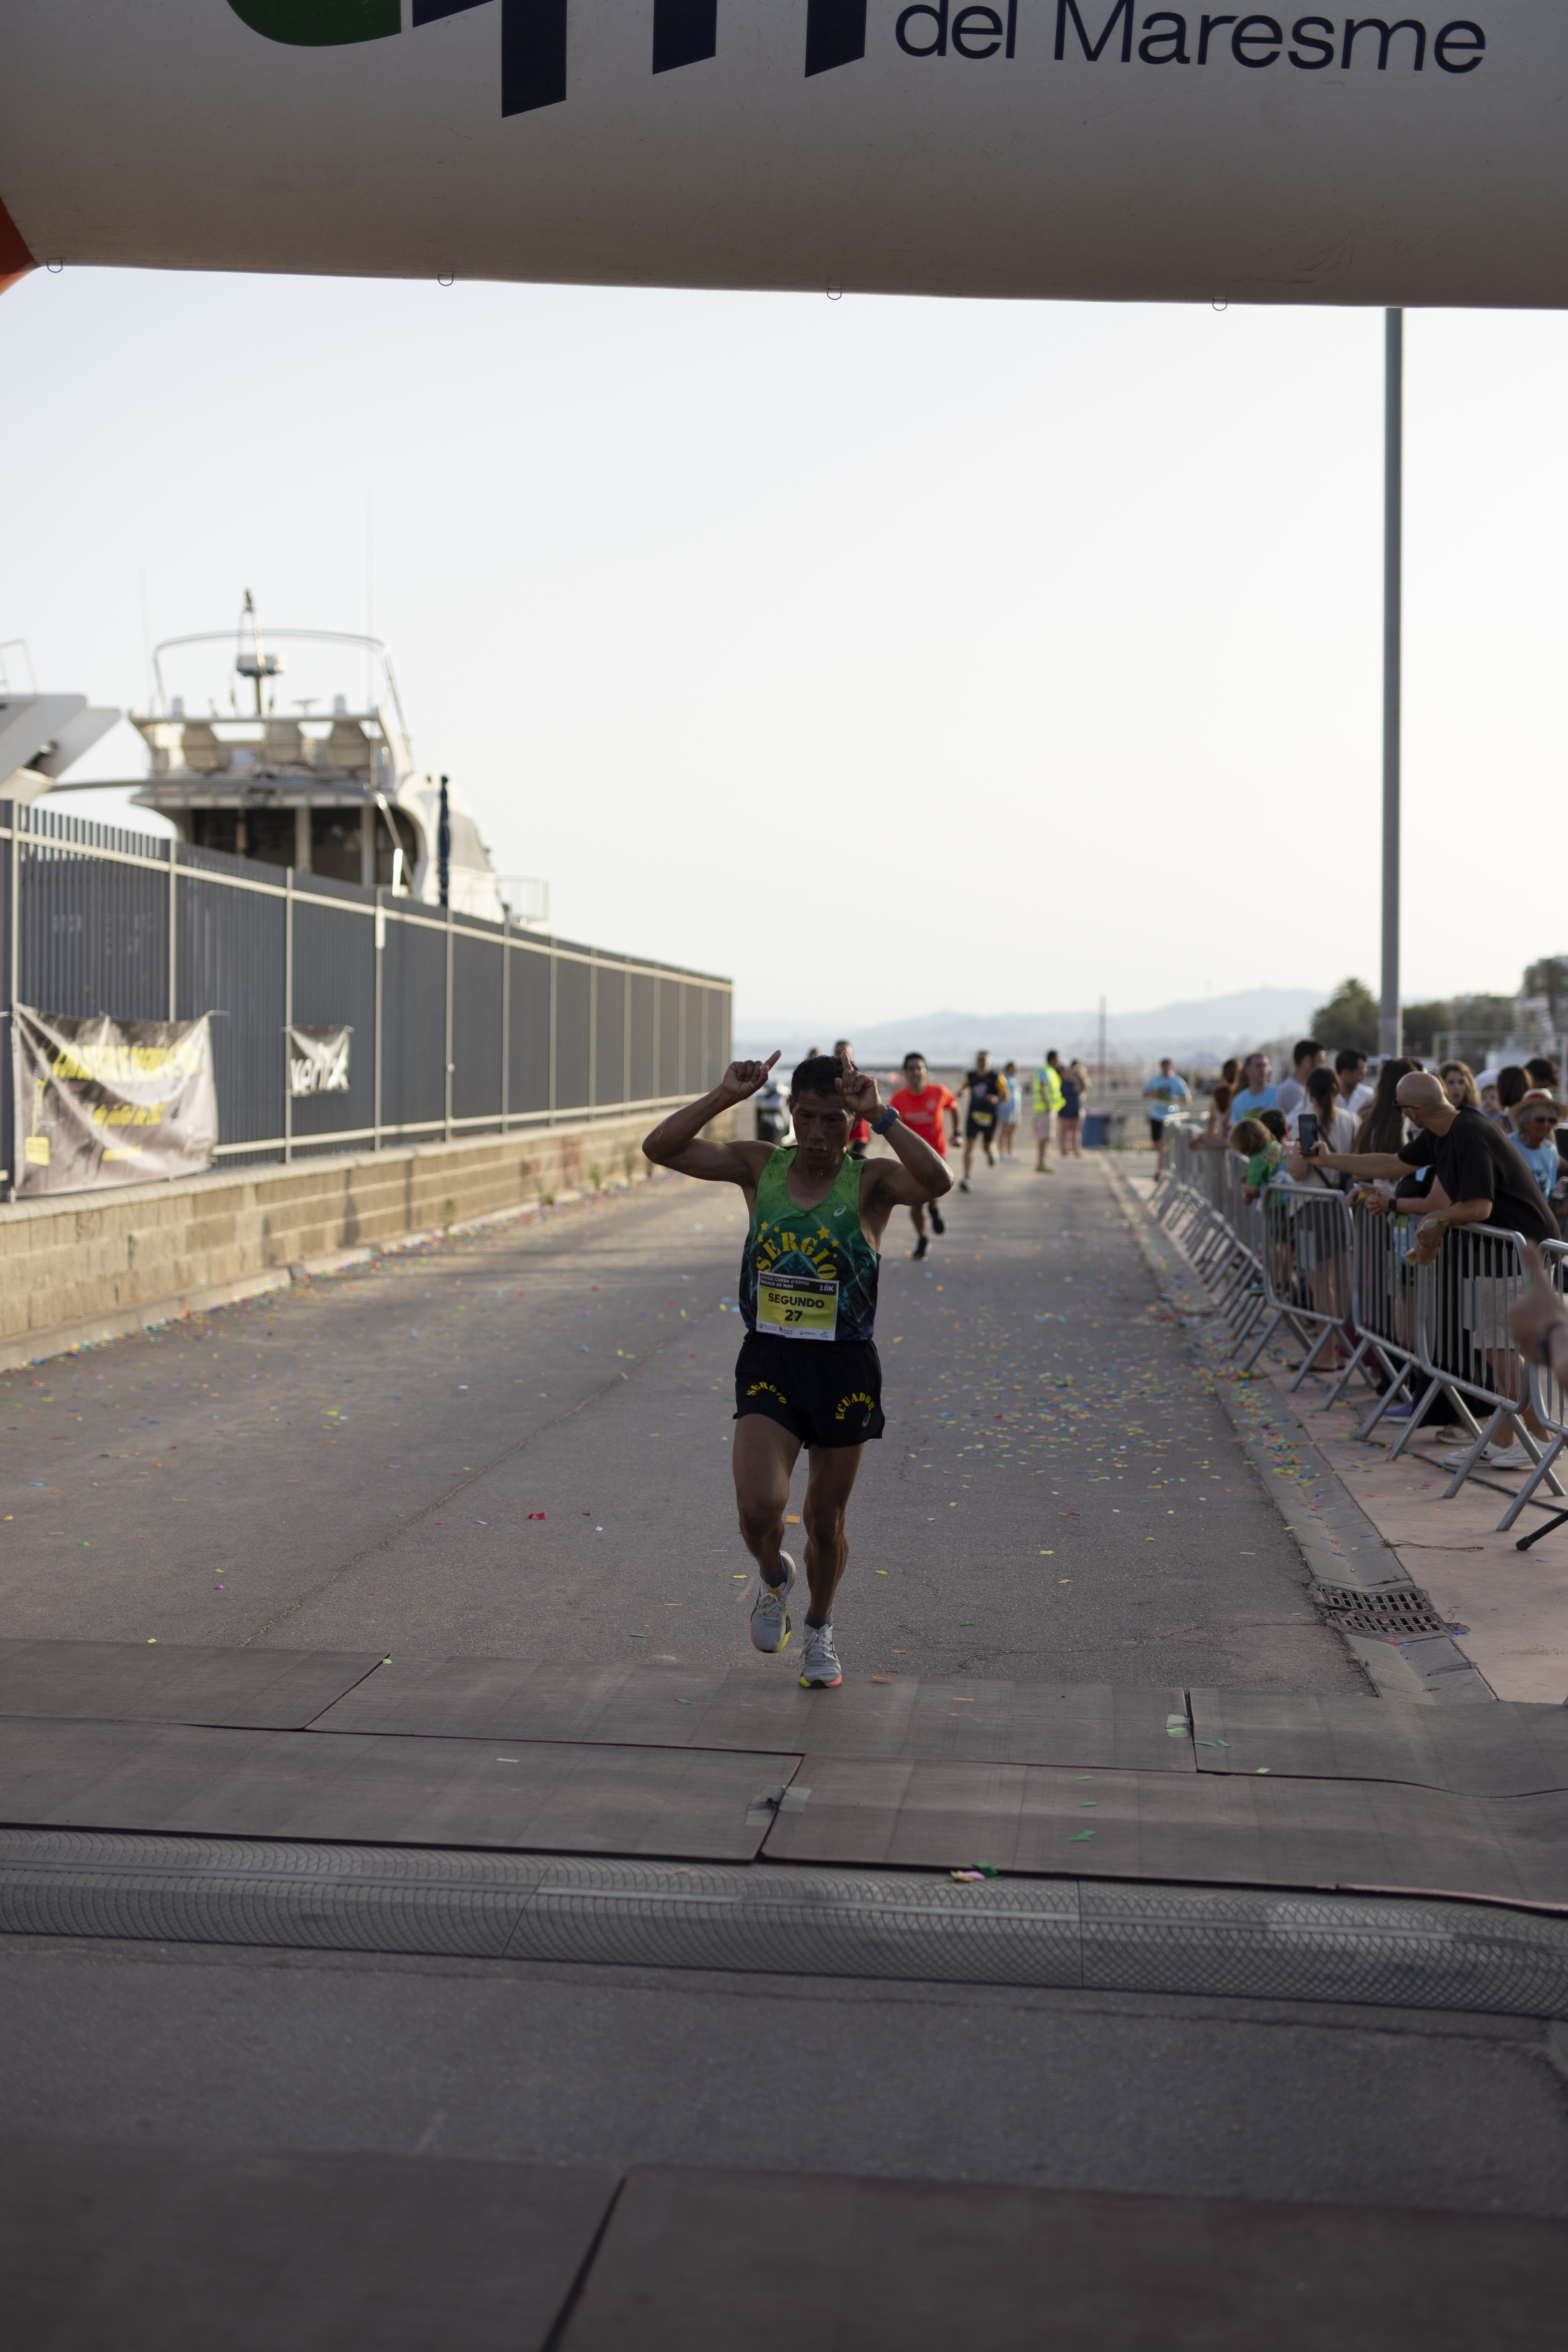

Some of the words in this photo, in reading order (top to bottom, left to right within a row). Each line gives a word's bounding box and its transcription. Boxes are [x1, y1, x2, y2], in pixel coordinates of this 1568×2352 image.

[894, 0, 1016, 60] del
[1054, 0, 1486, 74] Maresme
[756, 1232, 836, 1279] SERGIO
[768, 1292, 825, 1308] SEGUNDO
[784, 1309, 803, 1322] 27
[836, 1392, 874, 1419] ECUADOR
